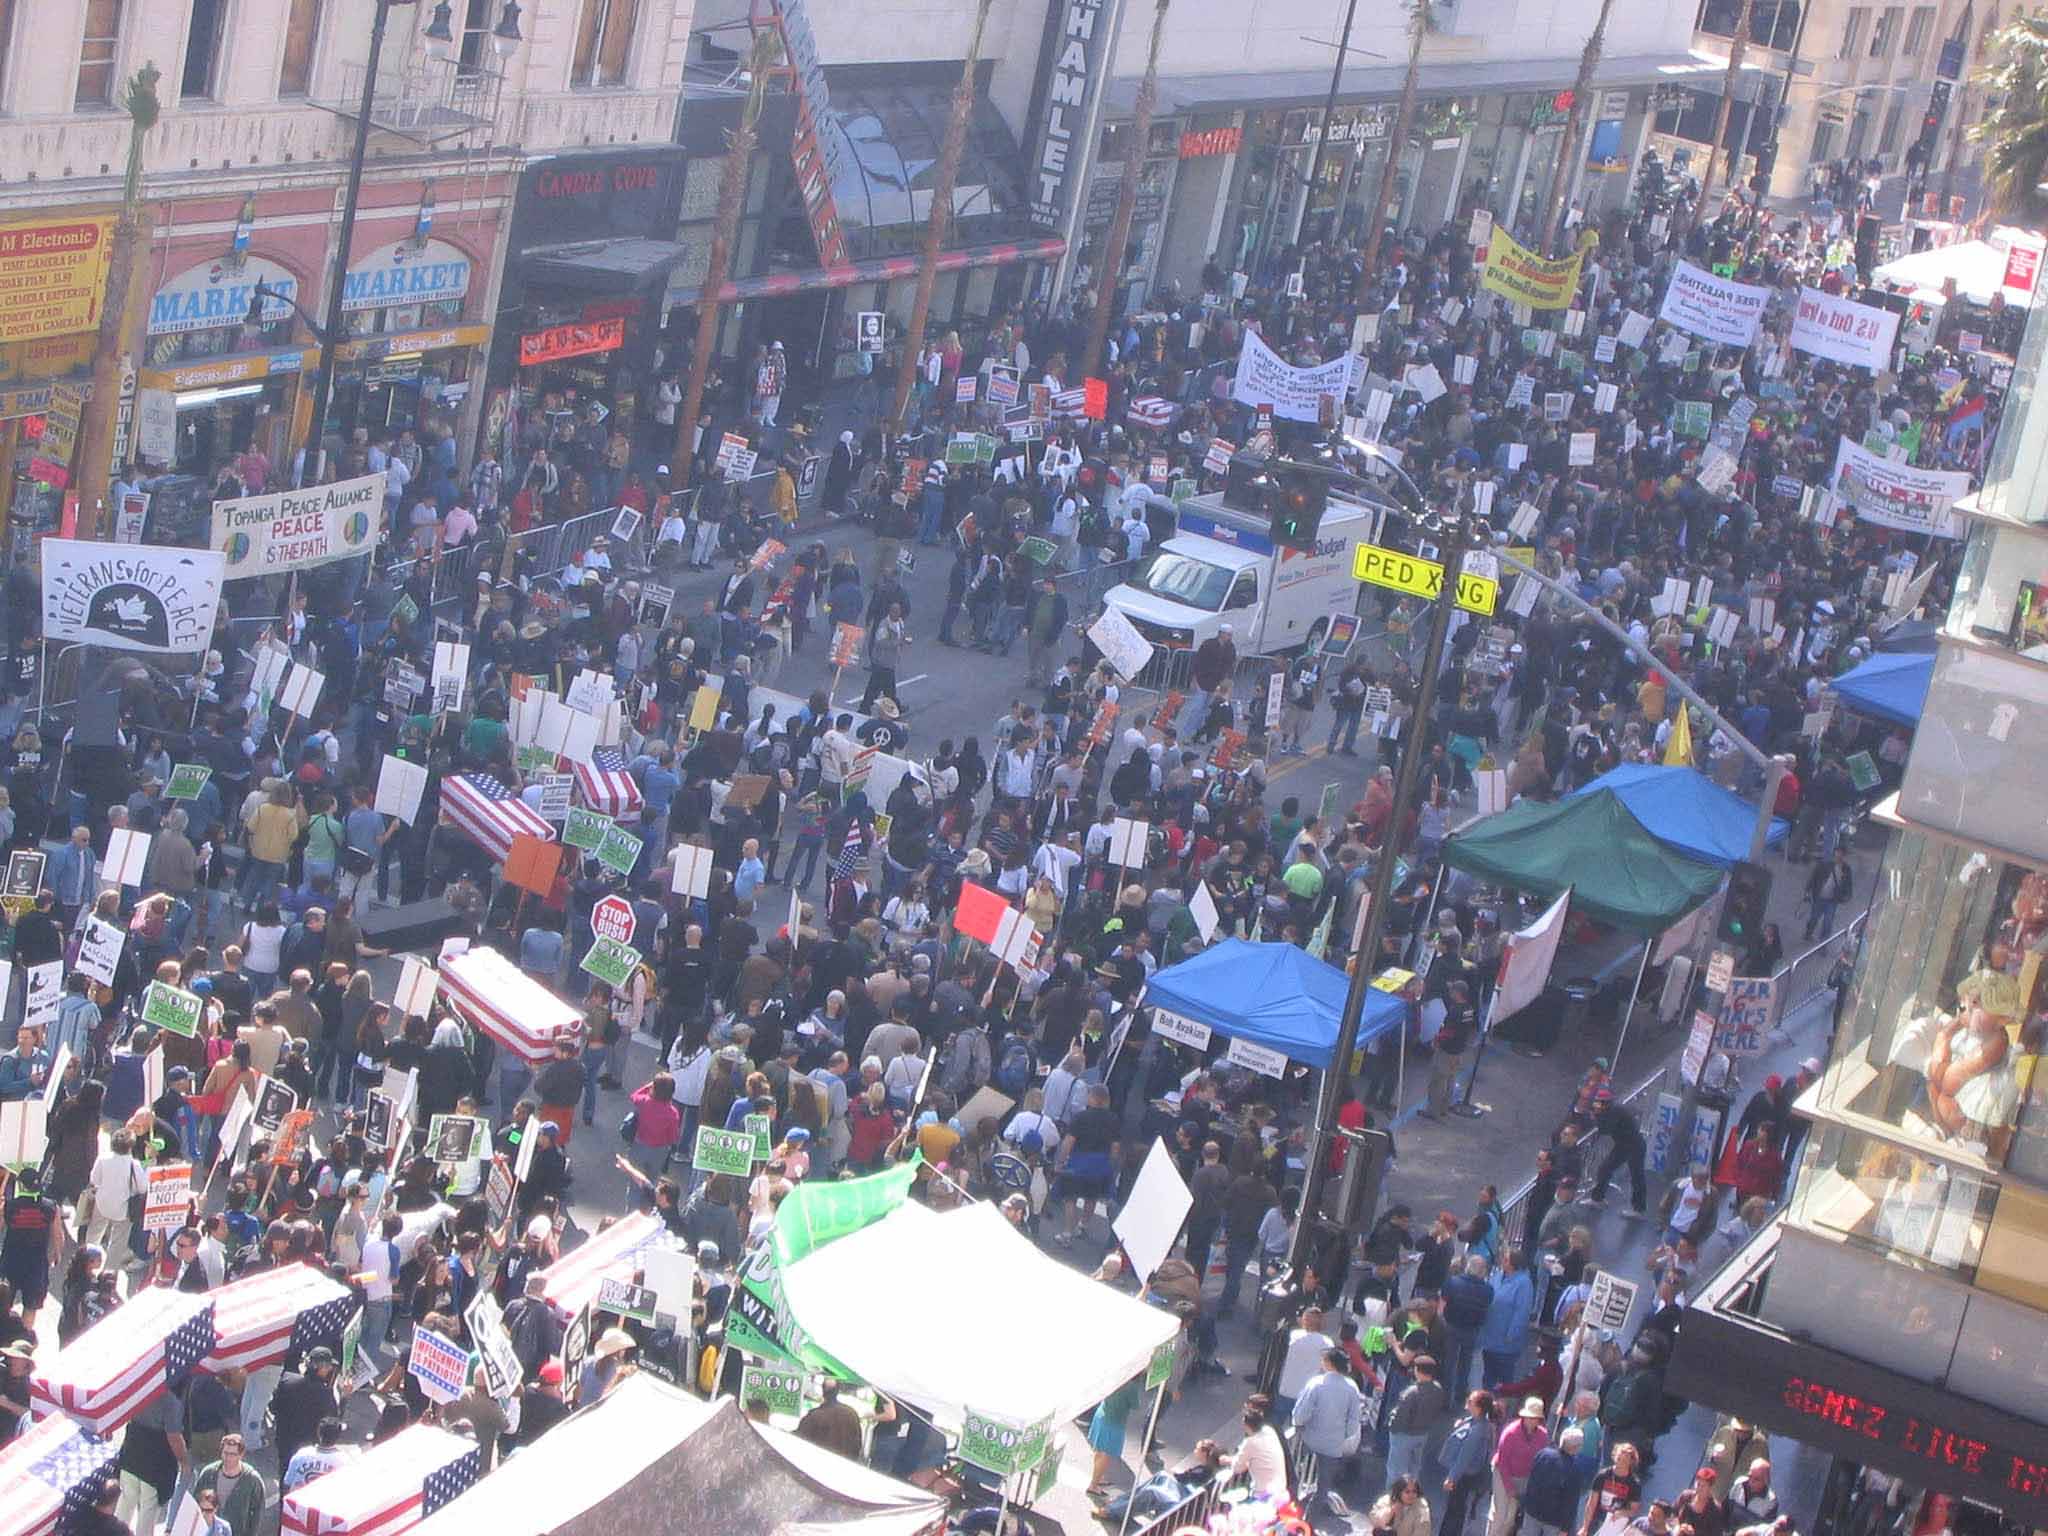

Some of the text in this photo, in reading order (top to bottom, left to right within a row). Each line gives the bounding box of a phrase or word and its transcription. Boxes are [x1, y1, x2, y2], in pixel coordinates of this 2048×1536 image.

[1039, 6, 1096, 204] HAMLET
[1303, 117, 1386, 142] Amican Apparel
[536, 166, 657, 197] CANDLE COVE
[21, 230, 93, 249] Electronic
[343, 261, 468, 300] MARKET
[224, 486, 373, 526] TOPANGA PEACE ALLIANCE
[272, 513, 324, 539] PEACE
[279, 544, 302, 561] THE
[301, 537, 328, 557] PATH
[1366, 553, 1413, 584] PED
[60, 559, 198, 645] VETERANS for PEACE
[597, 918, 628, 941] BUSH
[600, 904, 630, 925] STOP
[156, 1192, 178, 1204] NOT
[415, 1340, 466, 1378] IMPEACHMENT
[423, 1356, 463, 1386] PATRIOTIC
